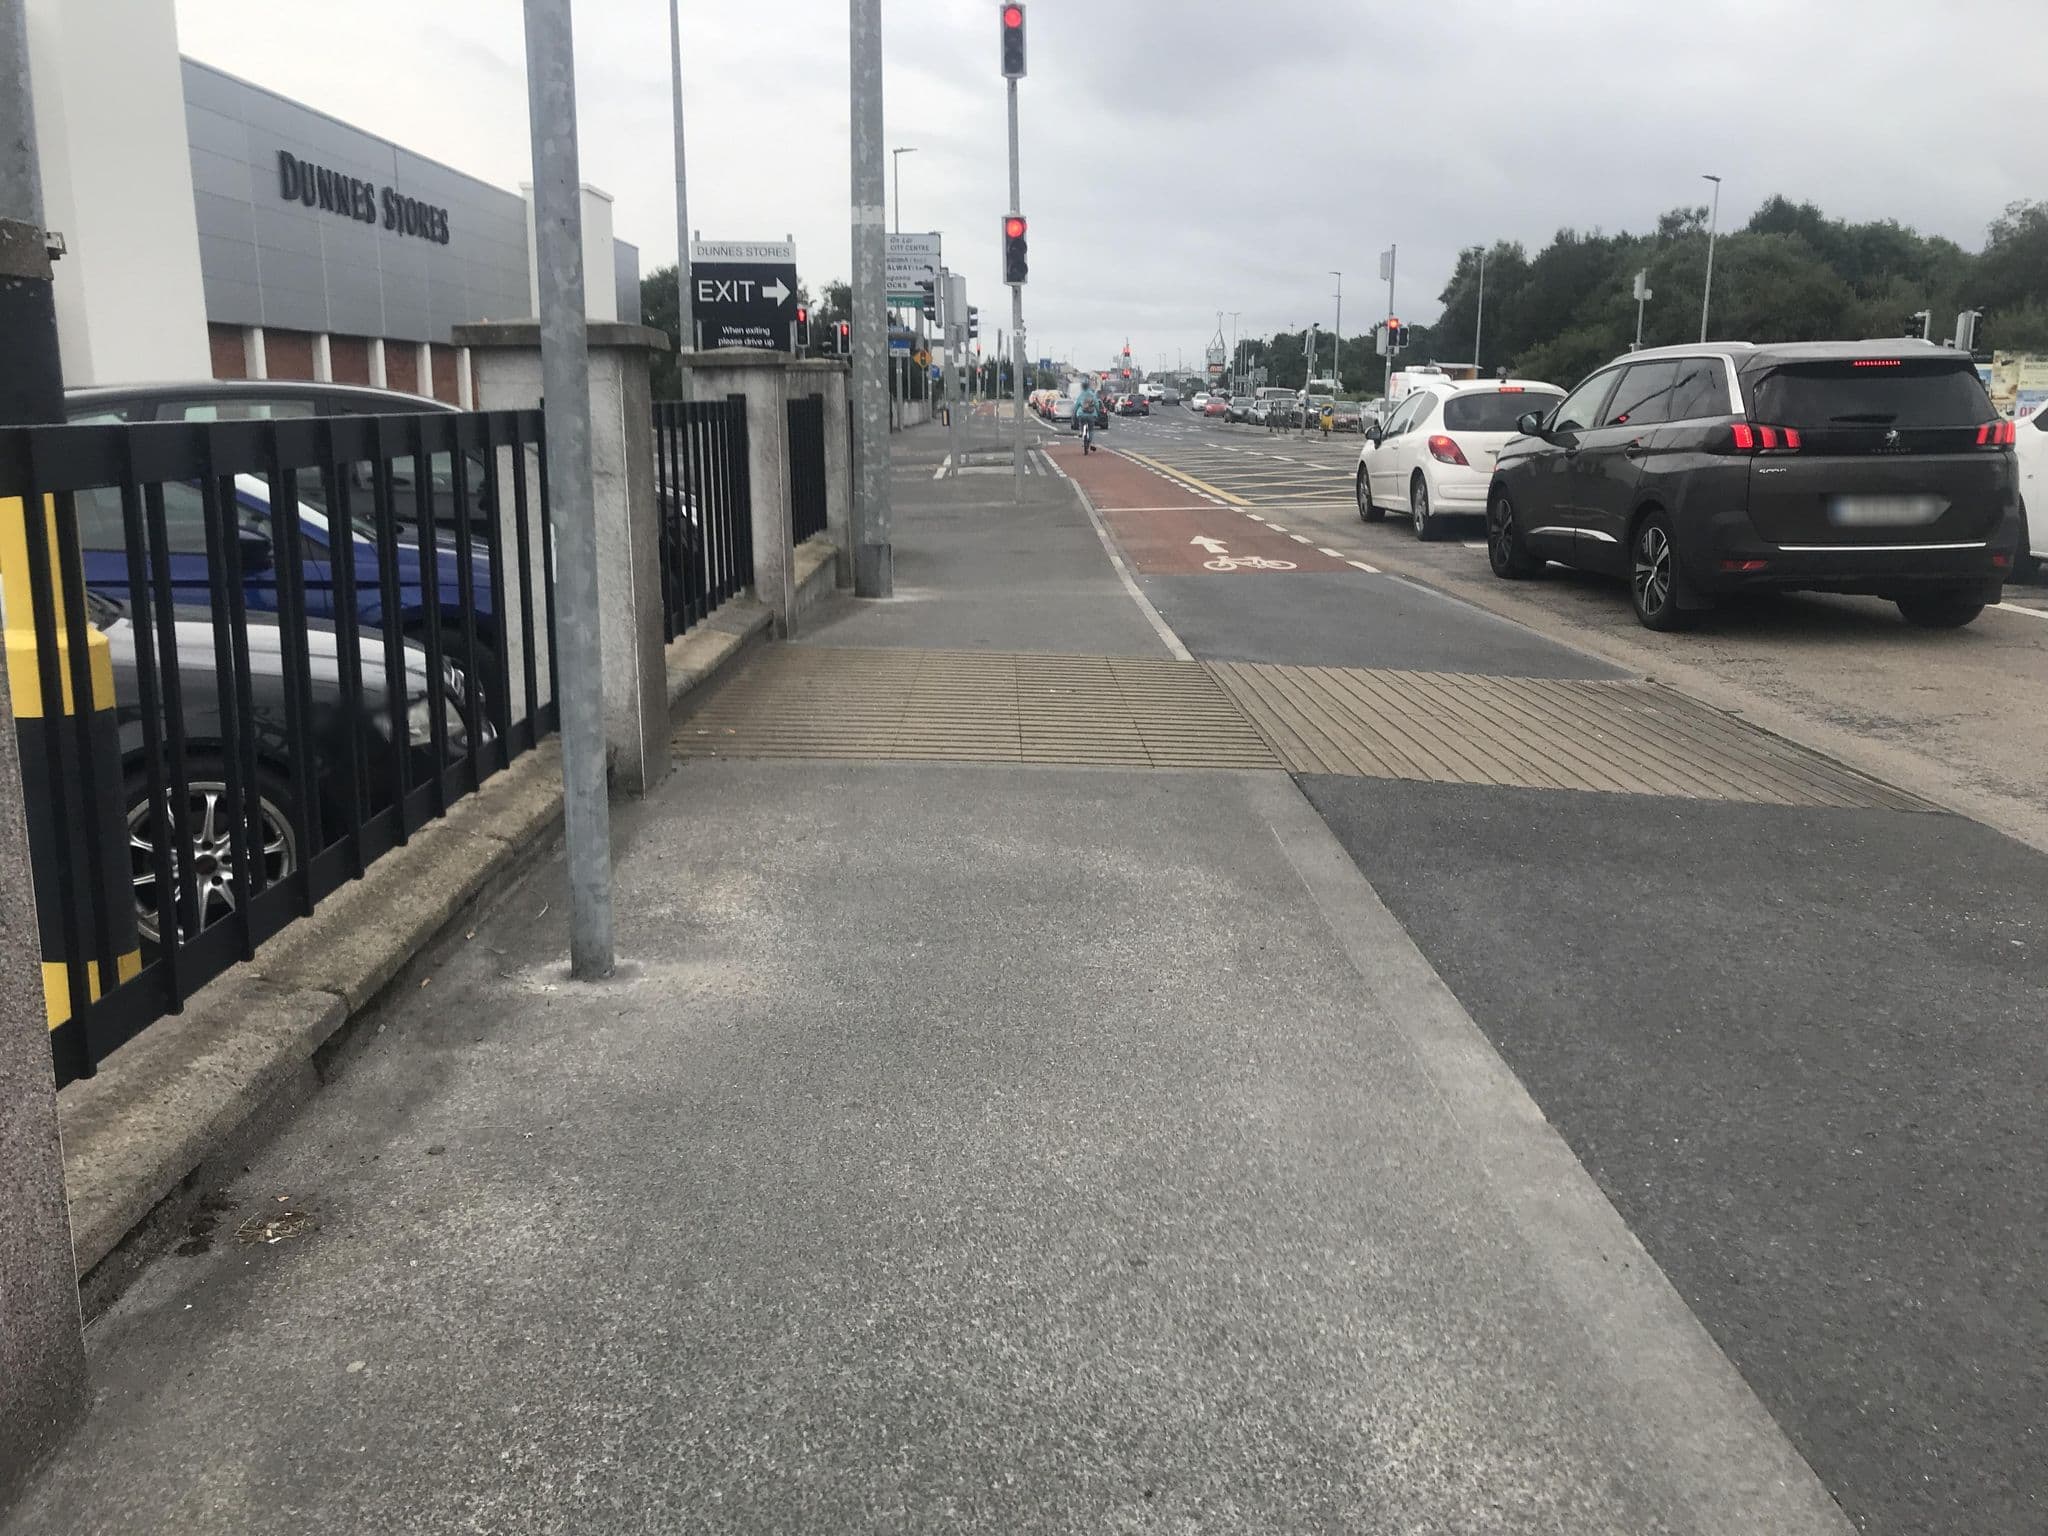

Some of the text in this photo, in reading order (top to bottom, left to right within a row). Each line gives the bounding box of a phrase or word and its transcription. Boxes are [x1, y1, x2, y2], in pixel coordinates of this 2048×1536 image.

[278, 150, 450, 245] DUNNES STORES
[697, 246, 790, 258] DUNNES STORES
[890, 244, 930, 252] CITY CENTRE
[698, 279, 756, 303] EXIT
[721, 326, 771, 336] When exiting
[718, 337, 775, 348] please drive up
